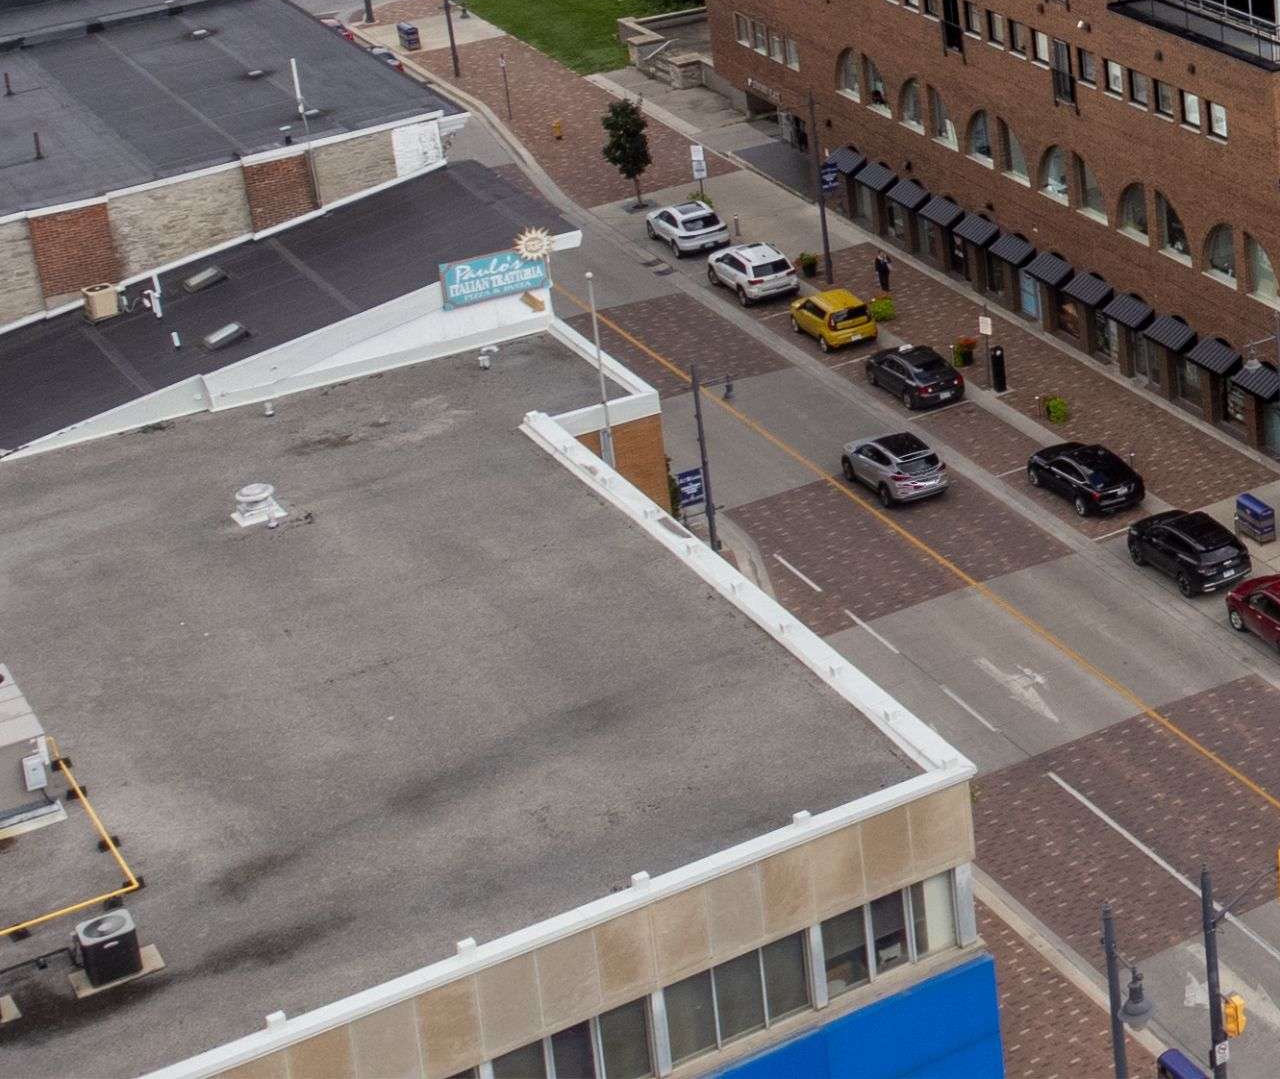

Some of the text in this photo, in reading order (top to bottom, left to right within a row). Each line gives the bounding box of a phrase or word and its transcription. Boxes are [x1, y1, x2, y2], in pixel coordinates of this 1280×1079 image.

[448, 266, 543, 297] ITALIAN TRATTORIA
[455, 255, 524, 284] Paulo's
